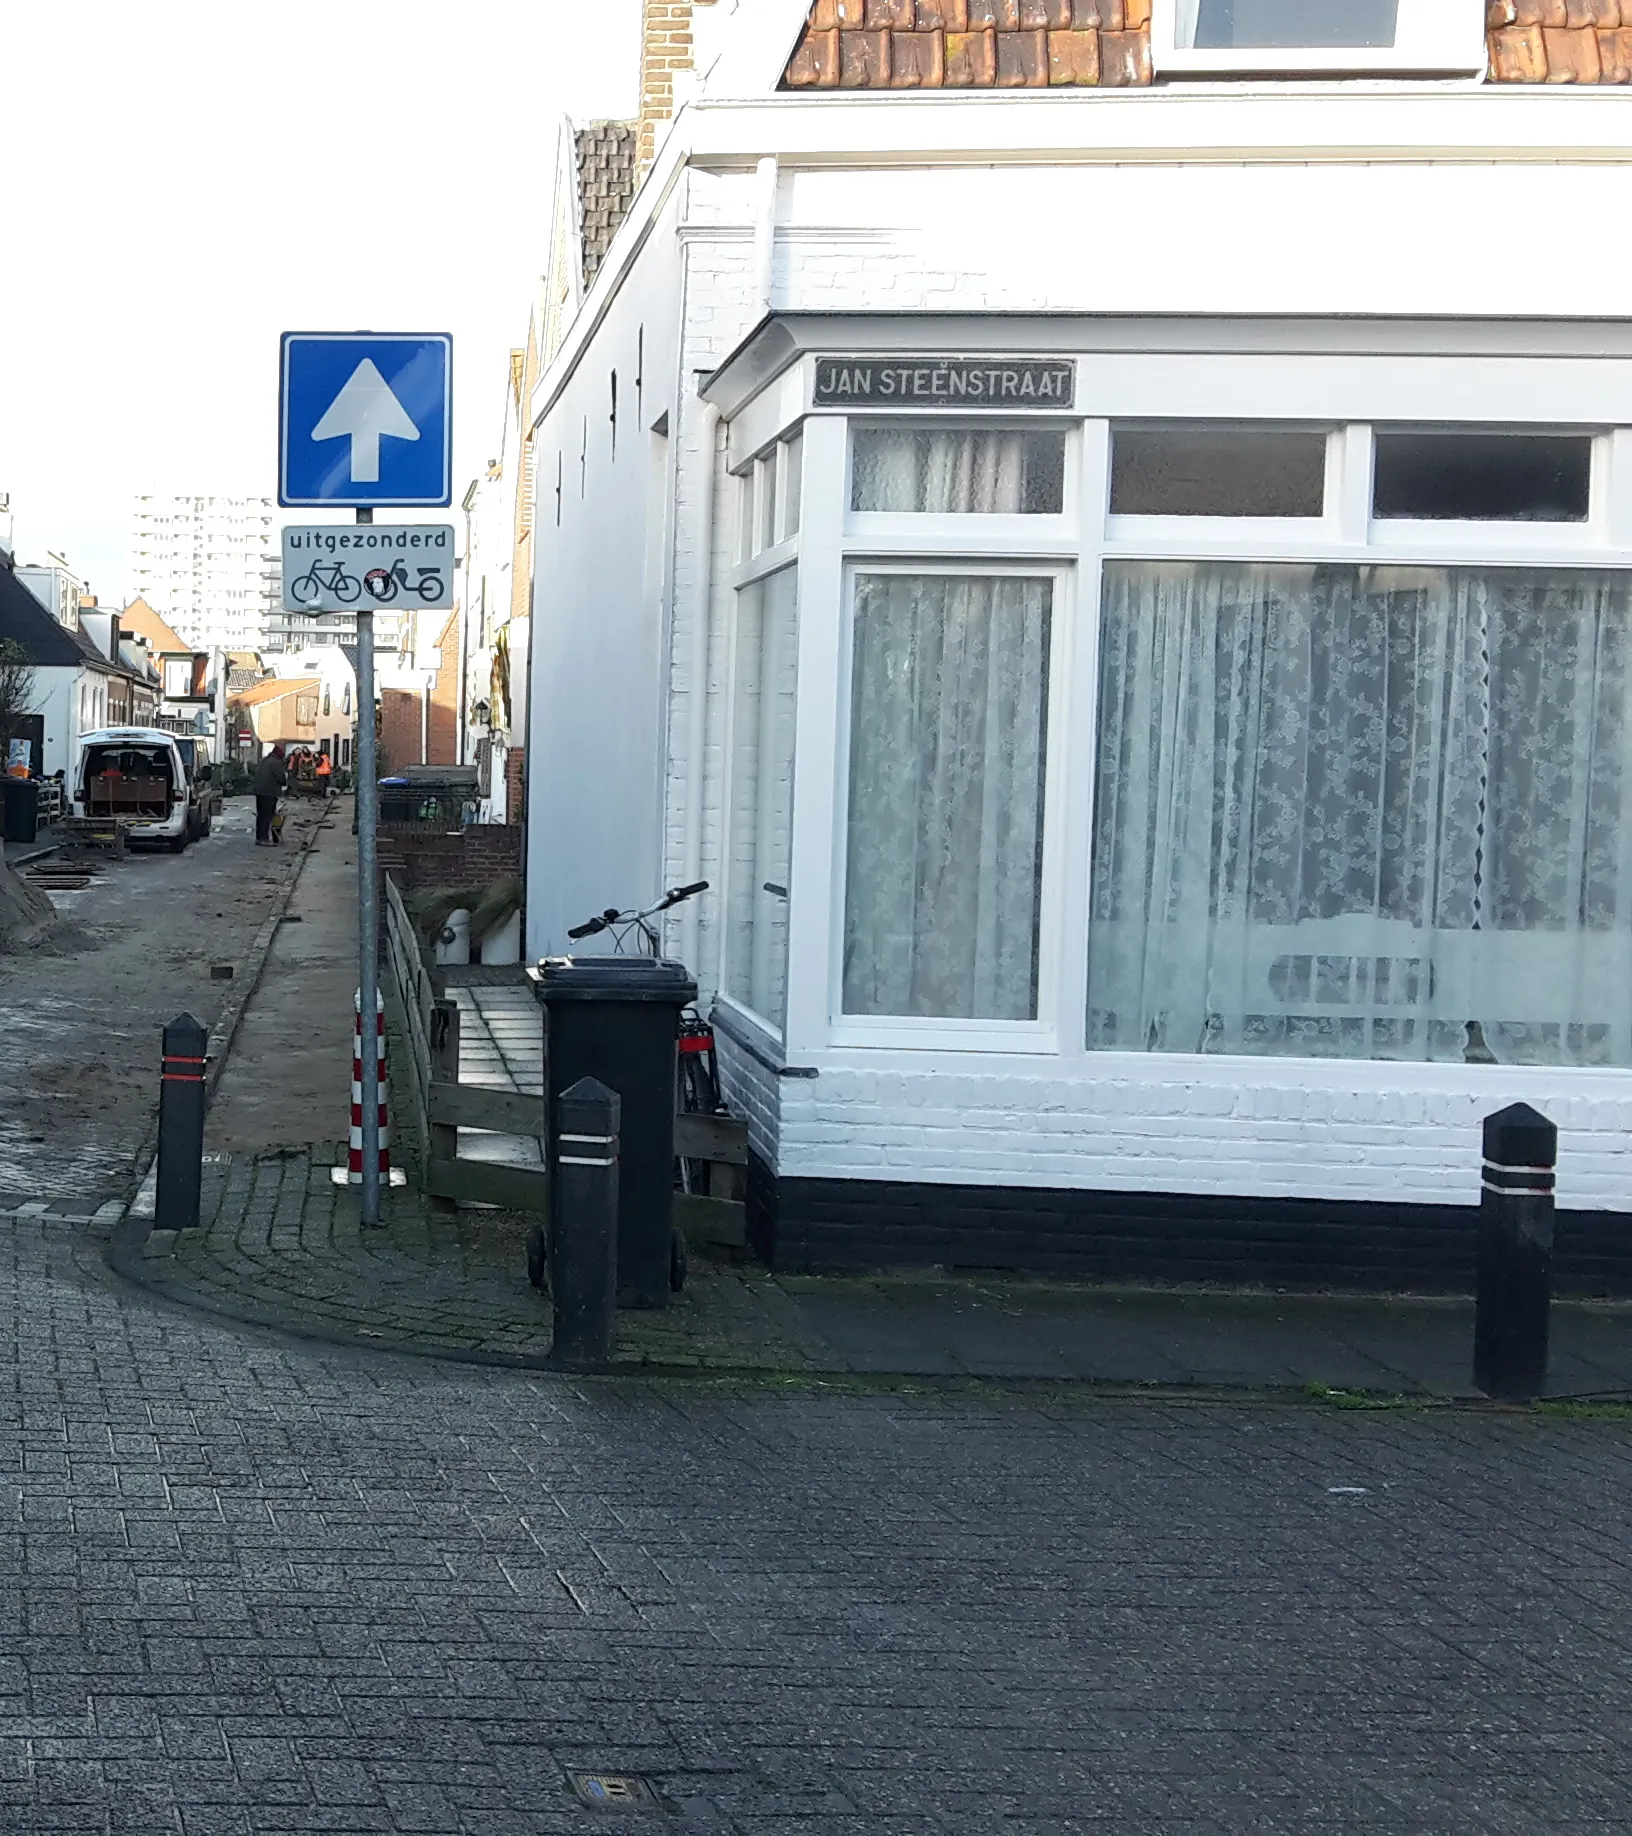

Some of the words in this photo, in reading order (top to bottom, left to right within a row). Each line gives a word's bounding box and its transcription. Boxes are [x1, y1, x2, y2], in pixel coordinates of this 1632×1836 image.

[820, 369, 872, 394] JAN
[879, 369, 1069, 397] STEENSTRAAT
[290, 530, 446, 553] uitgezonderd
